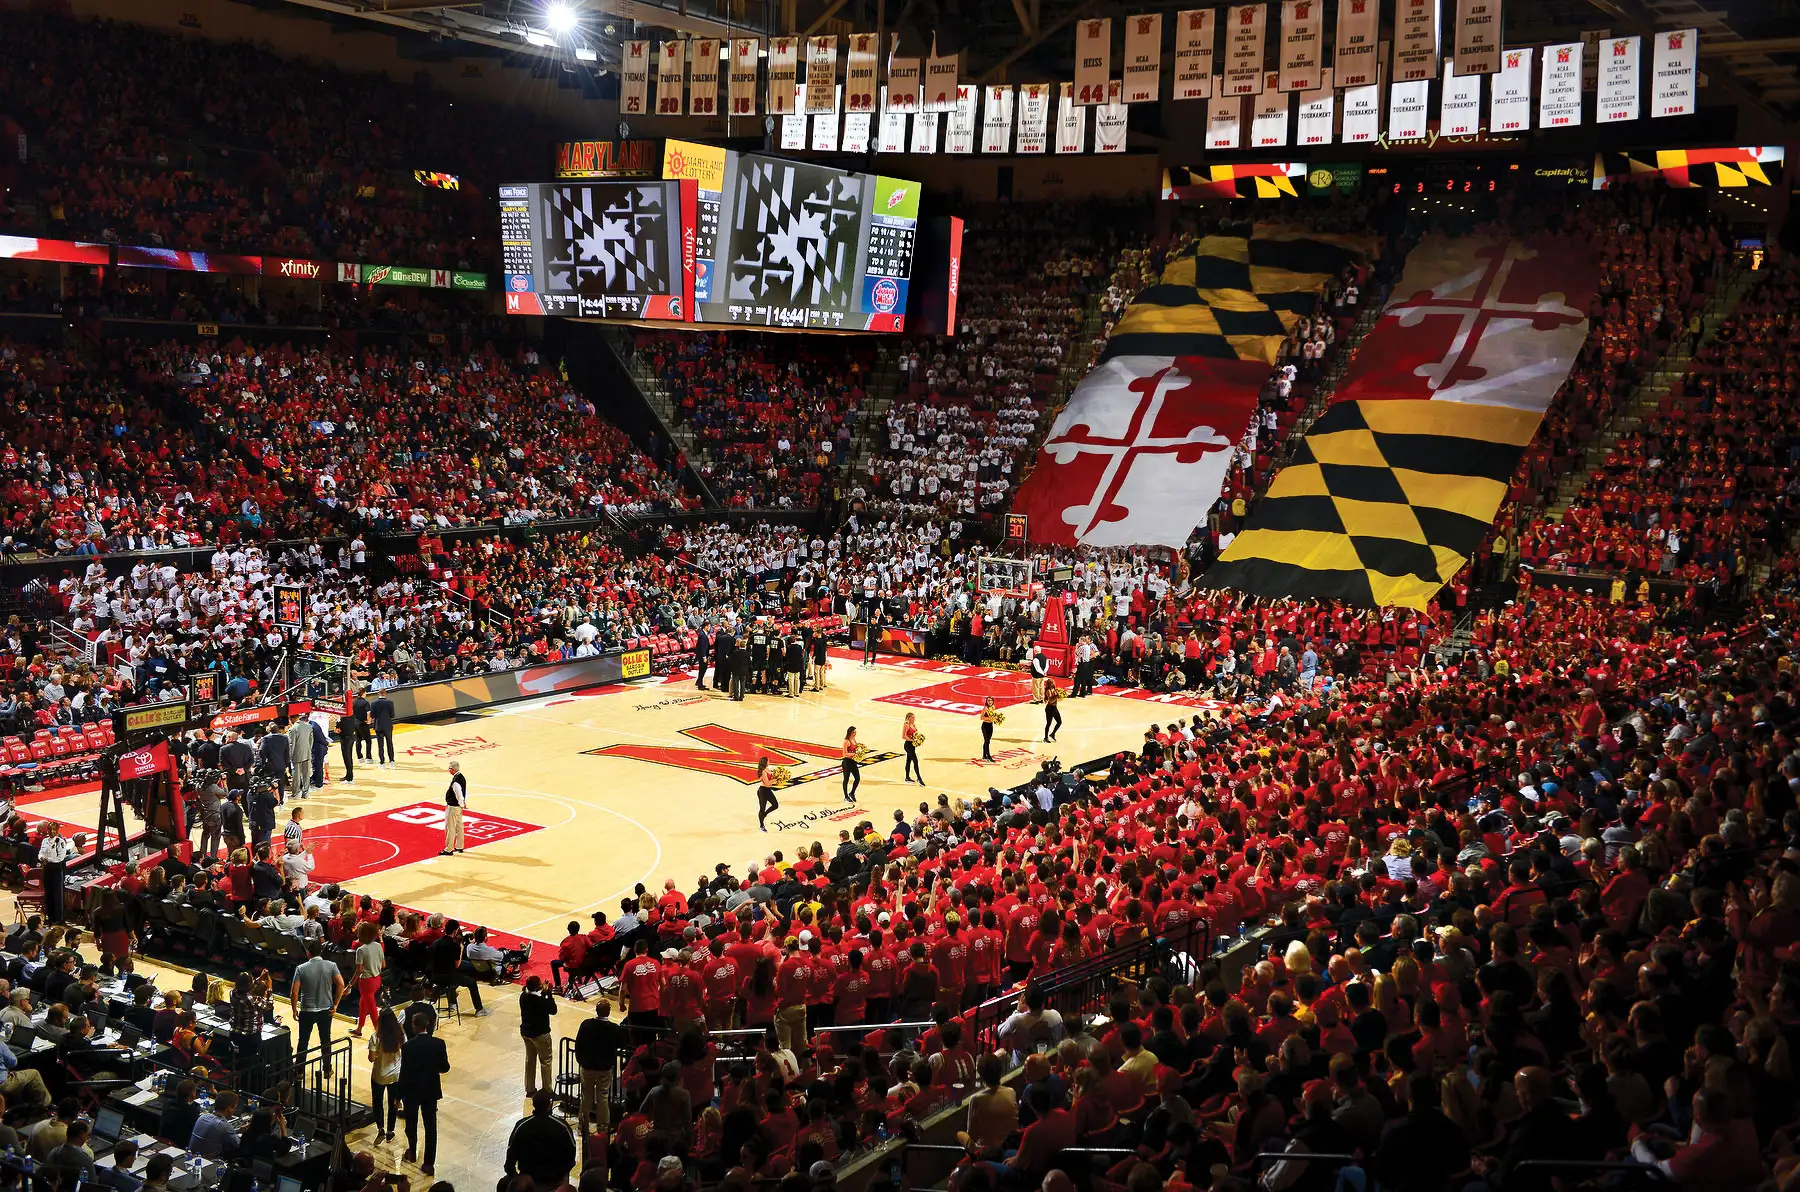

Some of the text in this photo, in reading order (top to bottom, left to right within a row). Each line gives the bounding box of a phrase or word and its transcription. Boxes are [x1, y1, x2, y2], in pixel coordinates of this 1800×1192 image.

[1472, 6, 1486, 14] AIAW
[1466, 16, 1492, 25] FINALIST
[1339, 45, 1374, 56] ELITE EIGHT
[1461, 45, 1494, 54] CHAMPIONS
[1084, 58, 1102, 68] HEISS
[1126, 64, 1158, 73] TOURNAMENT
[624, 73, 646, 82] THOMAS
[732, 74, 755, 82] HARPER
[852, 70, 872, 78] DORON
[891, 69, 918, 78] BULLETT
[1658, 68, 1692, 78] TOURNAMENT
[1080, 84, 1103, 103] 44
[1659, 90, 1688, 99] CHAMPIONS
[627, 97, 639, 112] 25
[660, 98, 678, 112] 20
[850, 94, 872, 110] 22
[555, 140, 656, 171] MARYLAND
[686, 156, 724, 171] MARYLAND
[685, 168, 716, 180] LOTTERY
[1394, 180, 1495, 194] 2 3 2 2 3
[683, 226, 695, 273] xfinity
[280, 260, 320, 278] xfinity
[344, 264, 355, 281] M
[436, 271, 446, 286] M
[950, 257, 959, 296] xfinity
[507, 294, 520, 310] M
[548, 302, 564, 310] 2 3
[581, 298, 603, 308] 14:44
[621, 303, 638, 312] 2 3
[774, 306, 804, 323] 14:44
[1009, 517, 1026, 525] 14:44
[1010, 525, 1022, 538] 30
[281, 602, 298, 622] 30
[622, 652, 648, 666] OLLIE'S
[198, 688, 211, 700] 30
[128, 711, 162, 726] OLLIE'S
[398, 736, 488, 756] xfinity
[434, 742, 503, 758] center
[135, 764, 156, 772] TOYOTA
